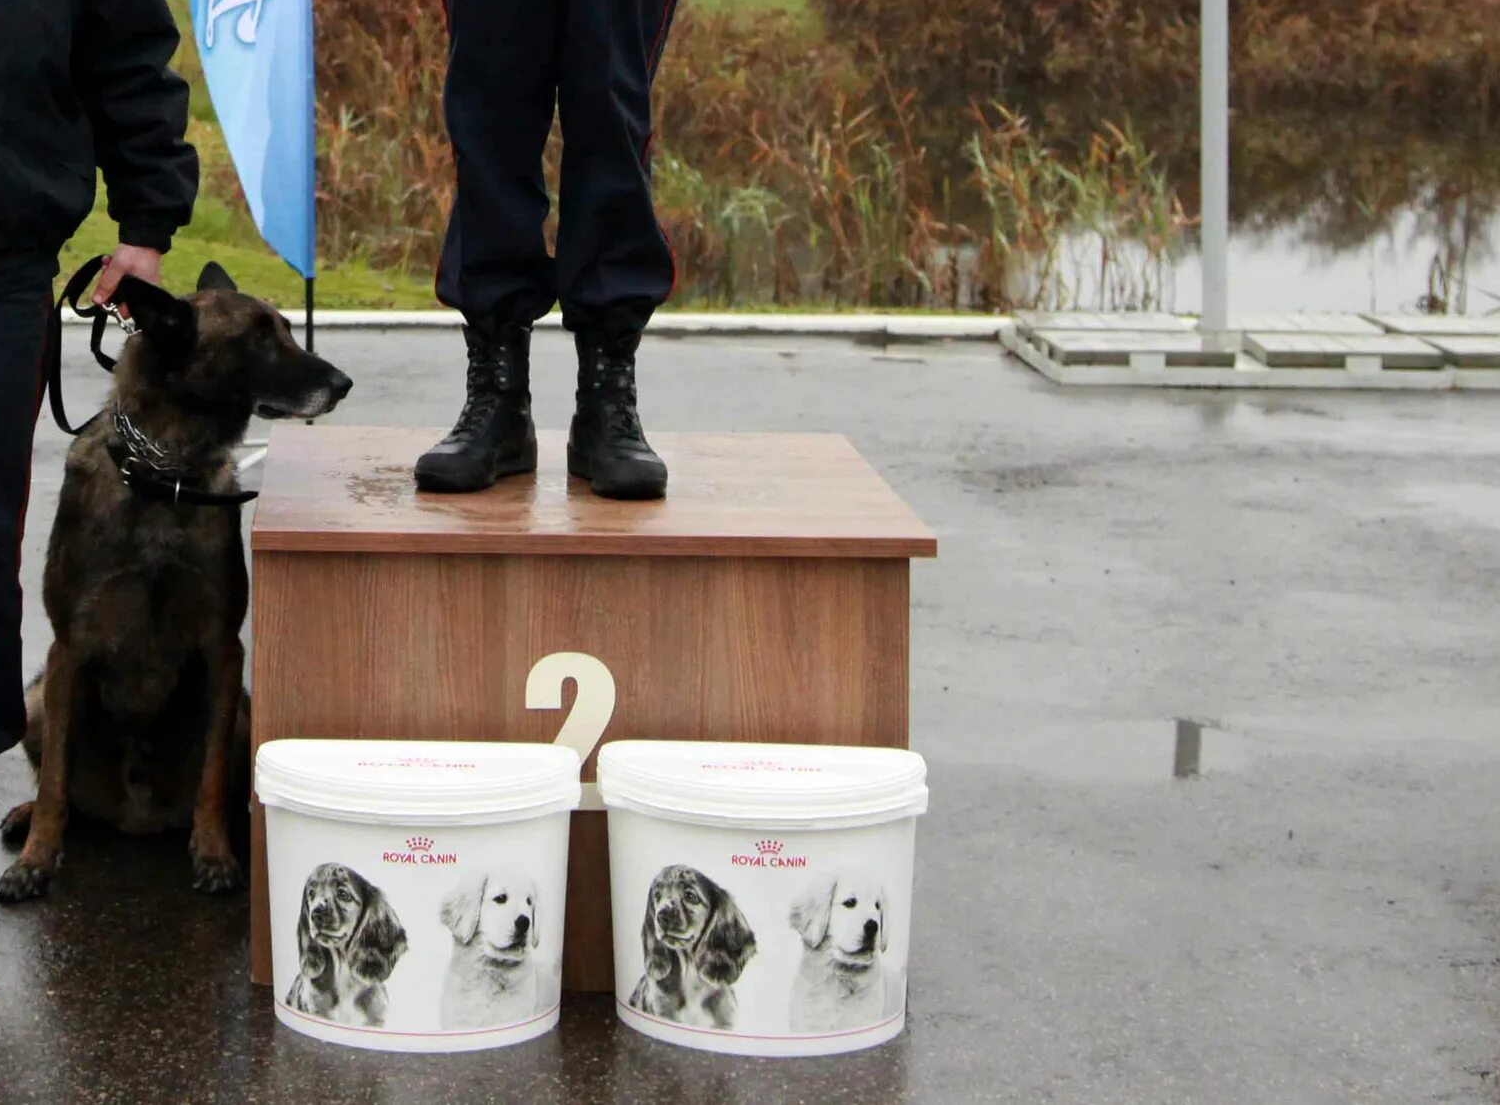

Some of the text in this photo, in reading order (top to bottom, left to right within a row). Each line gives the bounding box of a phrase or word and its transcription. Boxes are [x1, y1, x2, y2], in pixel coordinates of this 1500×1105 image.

[525, 652, 616, 811] 2
[383, 852, 457, 864] ROYAL CANIN
[731, 855, 807, 868] ROYAL CANIN
